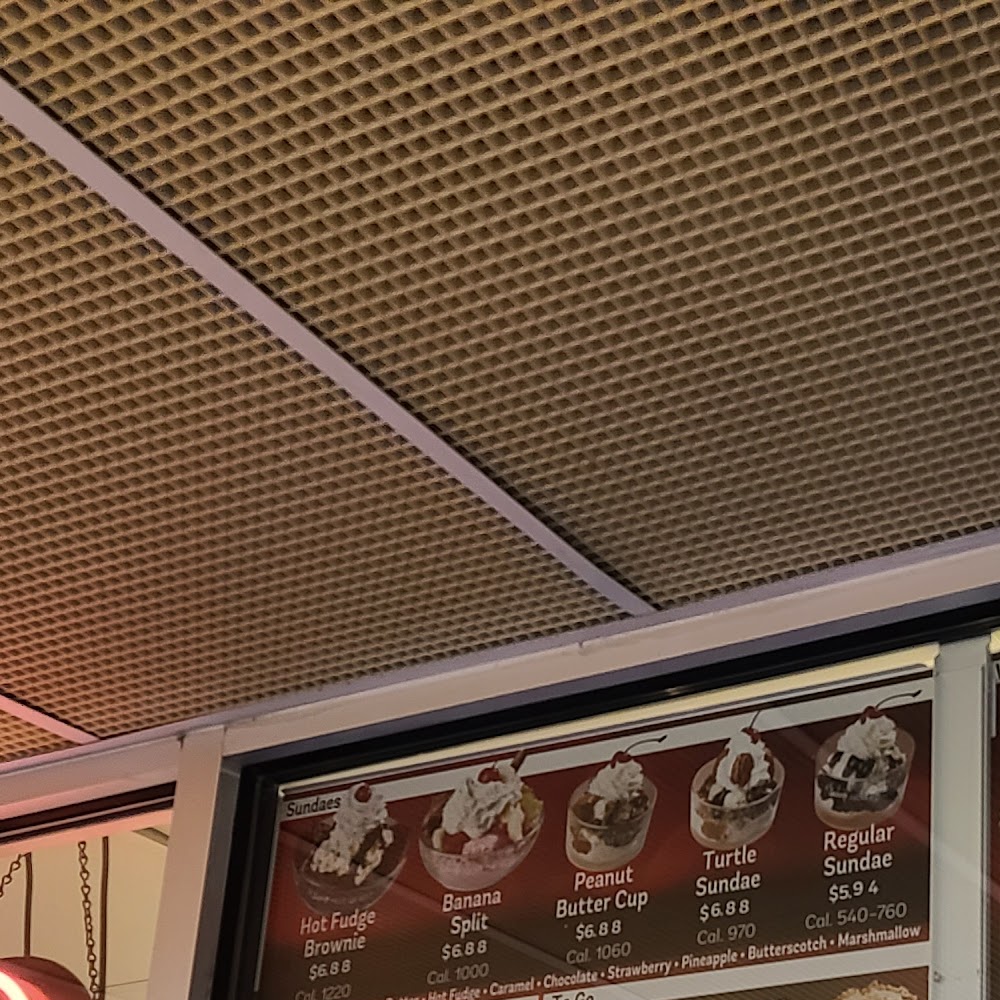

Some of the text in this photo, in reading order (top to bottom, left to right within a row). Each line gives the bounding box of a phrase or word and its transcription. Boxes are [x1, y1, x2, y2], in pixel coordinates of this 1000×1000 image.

[286, 797, 341, 817] Sundaes
[823, 823, 896, 854] Regular
[703, 845, 758, 871] Turtle
[823, 850, 893, 877] Sundae
[574, 866, 634, 891] Peanut
[695, 872, 761, 897] Sundae
[442, 889, 502, 913] Banana
[829, 879, 879, 903] $5.94
[556, 889, 649, 919] Butter Cup
[700, 899, 750, 923] $6.88
[804, 902, 908, 930] Cal. 540-760
[300, 908, 376, 935] Hot Fudge
[450, 912, 489, 939] Split
[576, 919, 622, 941] $6.88
[304, 932, 366, 958] Brownie
[696, 923, 757, 946] Cal. 970
[442, 940, 487, 961] $6.88
[489, 977, 535, 996] Caramel
[543, 969, 599, 989] Chocolate
[608, 959, 672, 981] Strawberry
[681, 949, 738, 969] Pineapple
[748, 936, 828, 960] Butterscotch
[837, 923, 922, 947] Marshmallow
[566, 942, 631, 965] Cal. 1060
[309, 959, 351, 981] $6.88
[427, 963, 490, 985] Cal. 1000
[322, 984, 350, 1000] 1220
